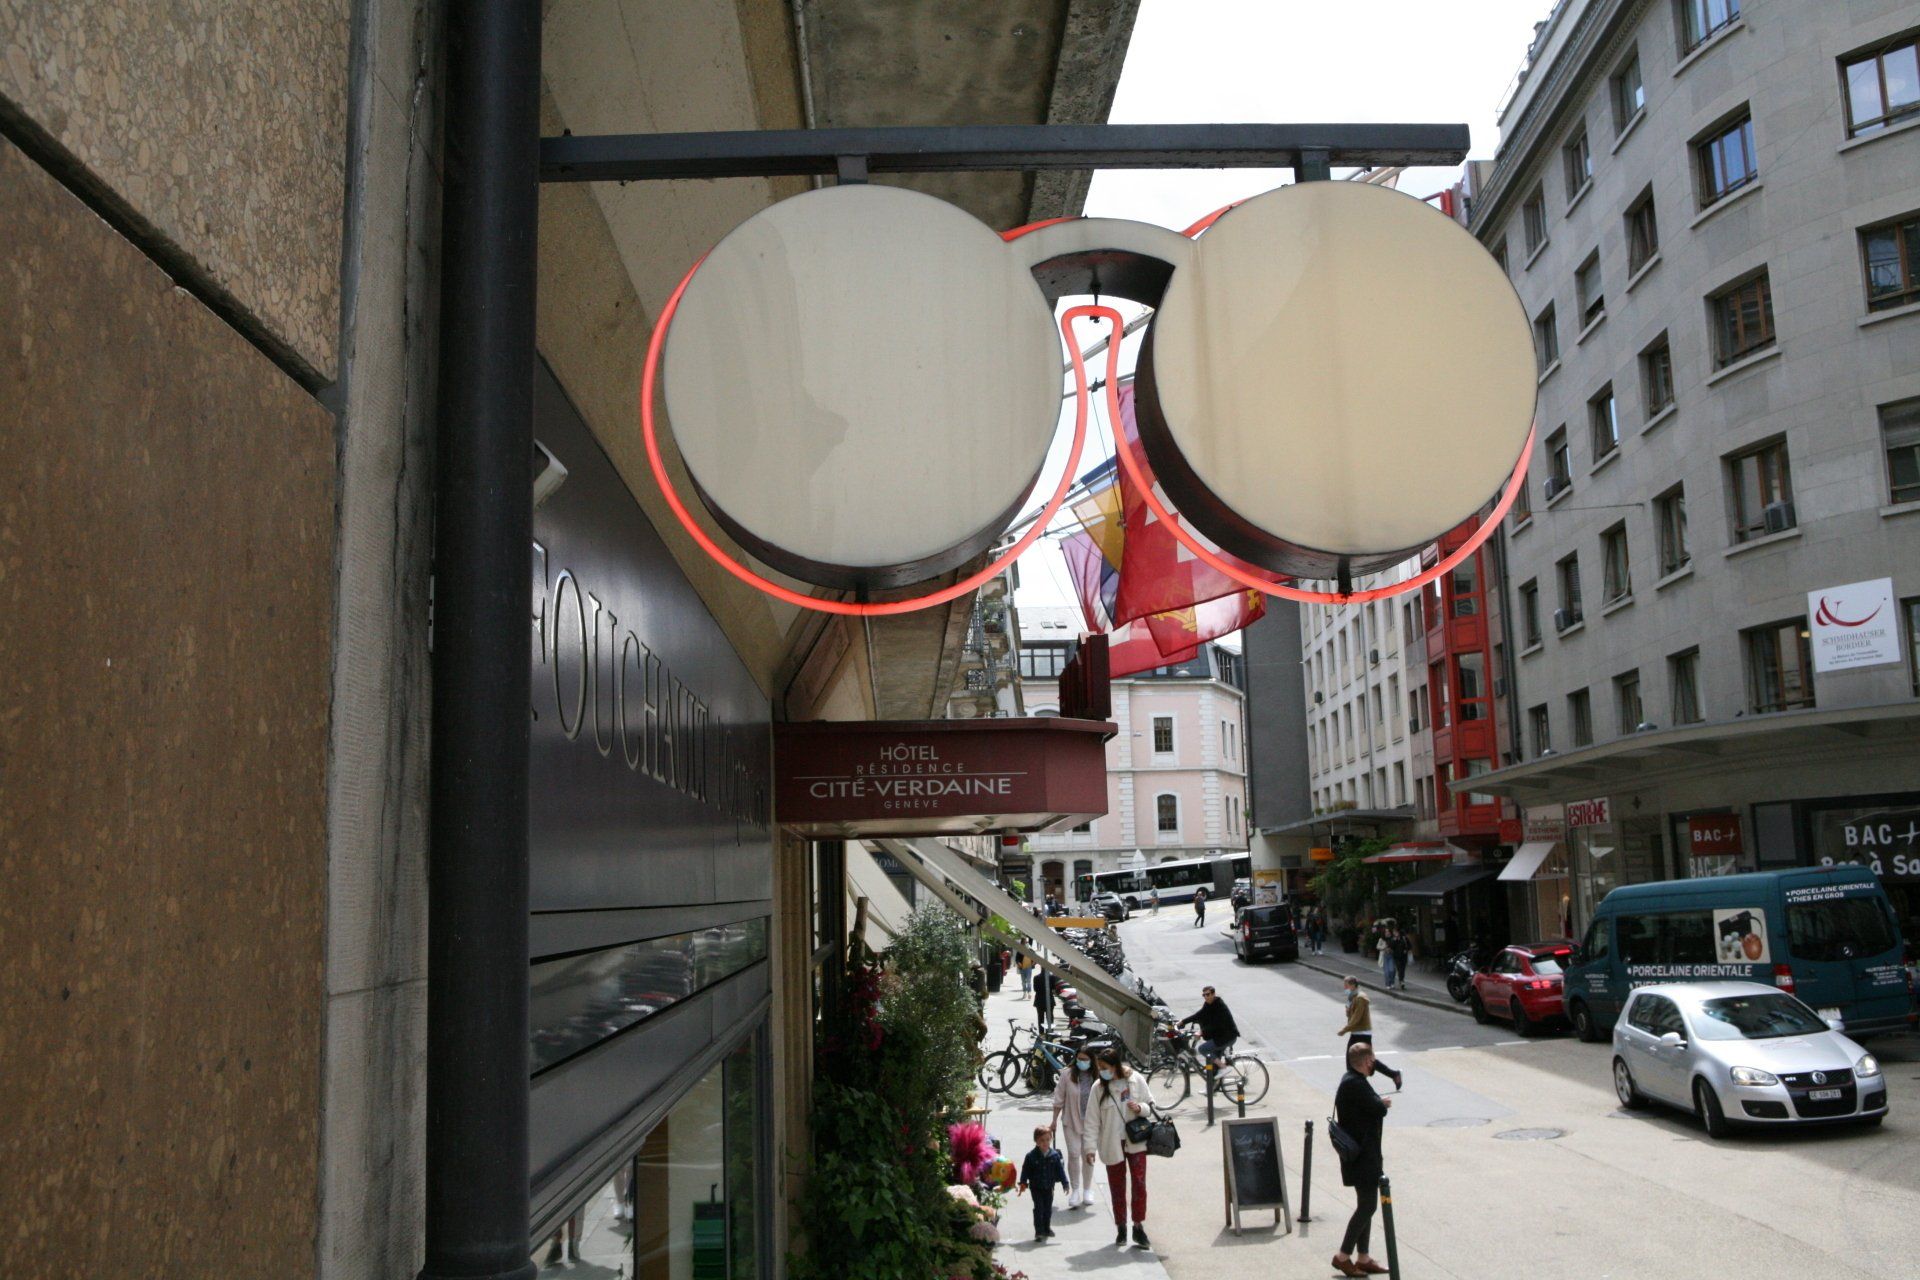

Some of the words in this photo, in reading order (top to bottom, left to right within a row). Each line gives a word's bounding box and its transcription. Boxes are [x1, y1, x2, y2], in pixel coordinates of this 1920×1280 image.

[880, 742, 939, 761] HÔTEL
[856, 763, 965, 775] RÉSIDENCE
[809, 777, 1012, 799] CITÉ-VERDAINE
[883, 799, 939, 809] GENÈVE
[1790, 885, 1837, 897] PORCELAINE
[1838, 882, 1875, 891] ORIENTALE
[1792, 895, 1812, 903] THES
[1813, 893, 1824, 901] EN
[1824, 892, 1845, 900] GROS
[1632, 965, 1692, 977] PORCELAINE
[1693, 964, 1753, 976] ORIENTALE
